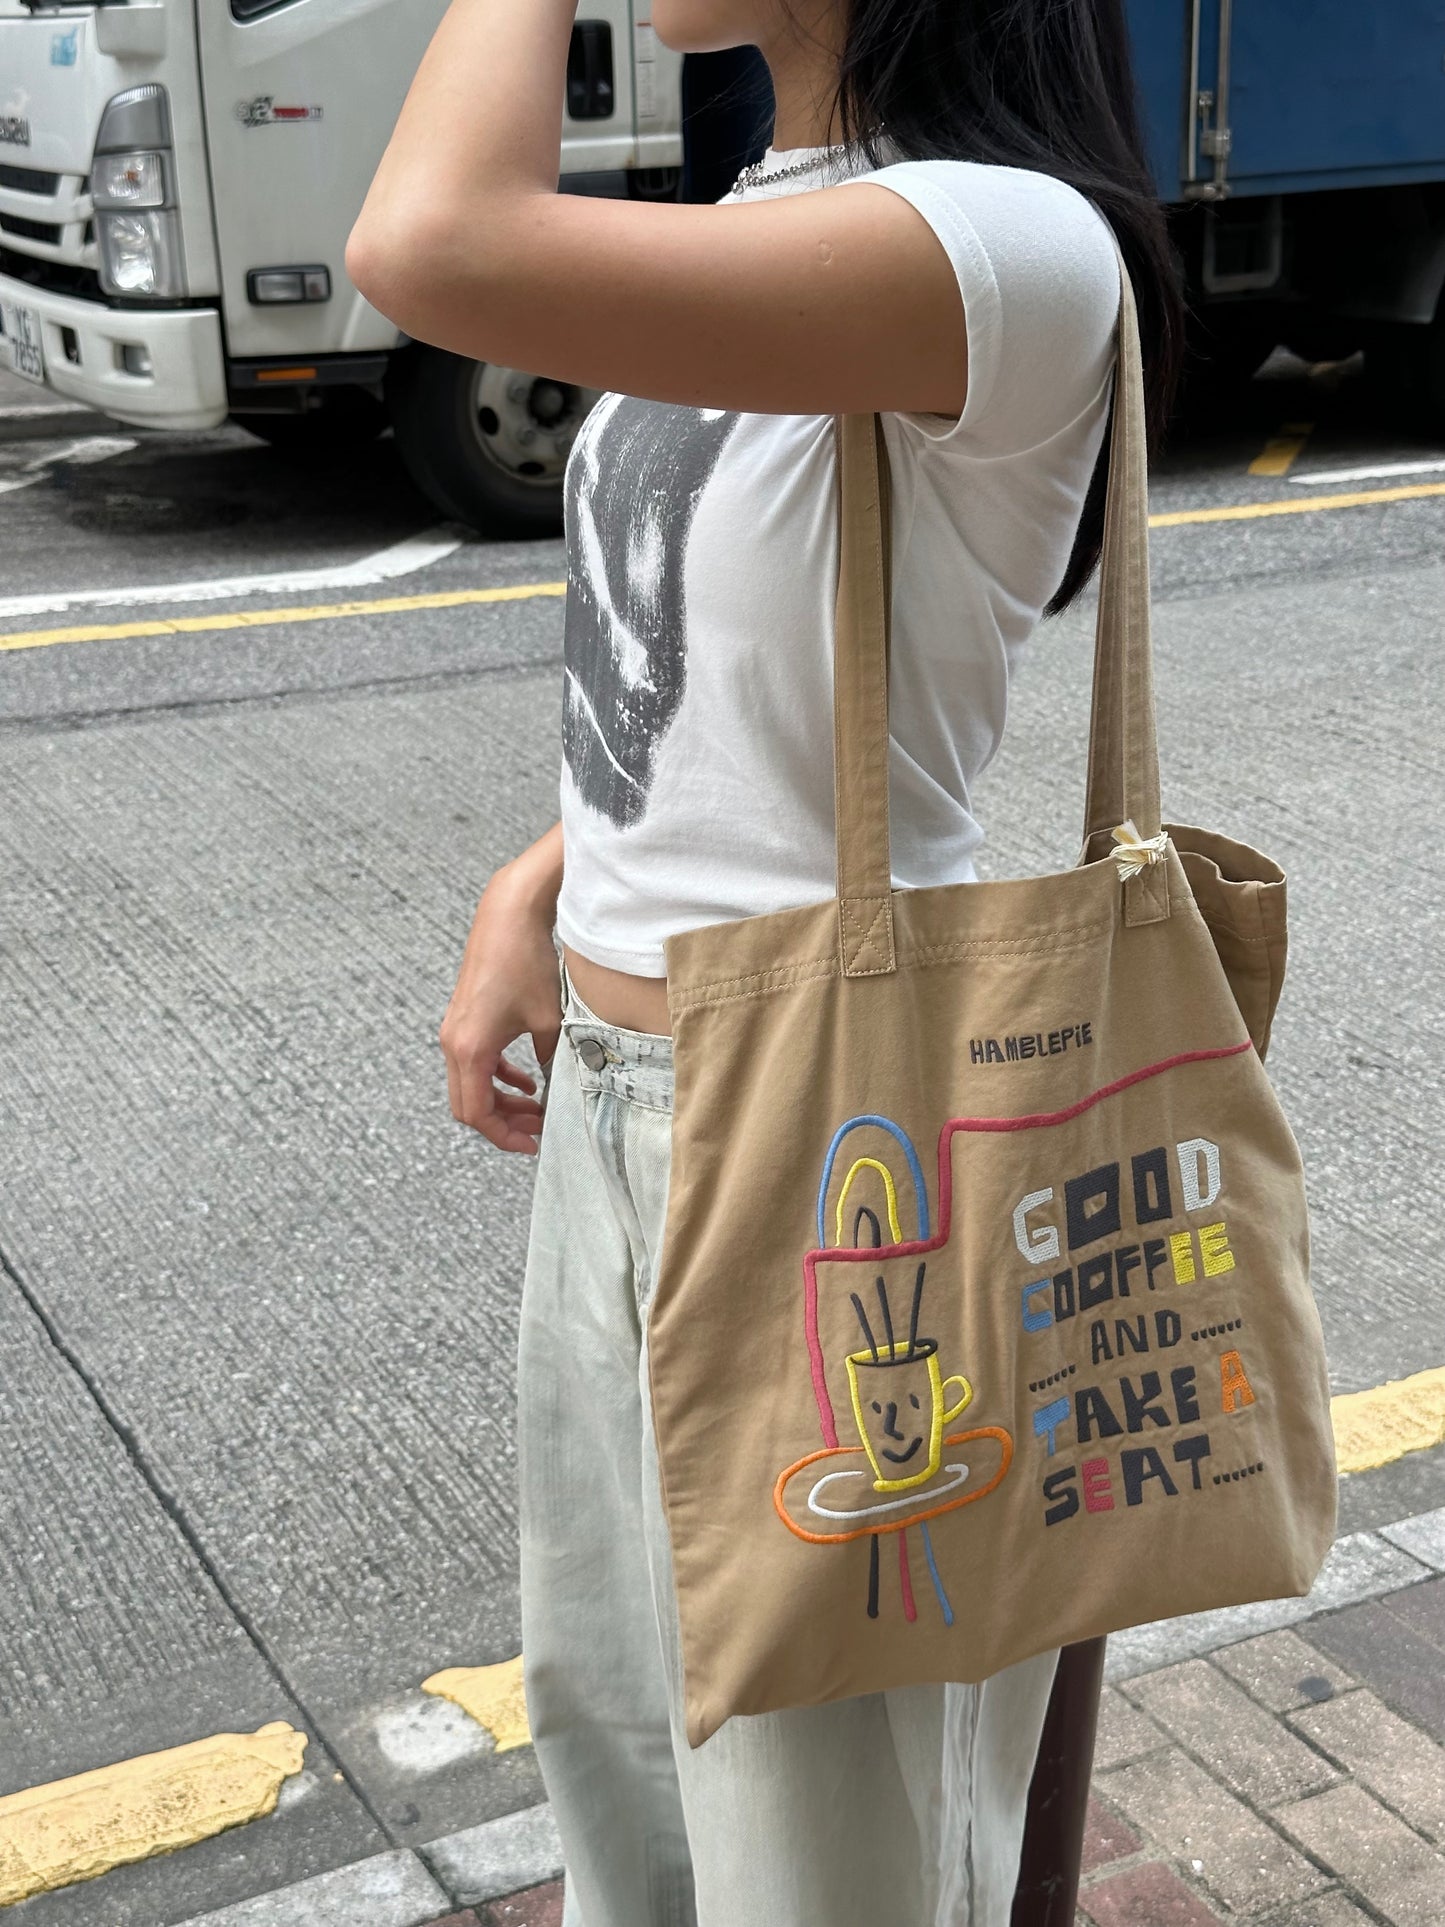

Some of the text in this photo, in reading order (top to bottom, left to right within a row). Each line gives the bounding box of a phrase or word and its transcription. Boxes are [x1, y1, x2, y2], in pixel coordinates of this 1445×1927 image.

[1012, 1137, 1222, 1264] GOOD
[1033, 1349, 1256, 1457] TAKE A
